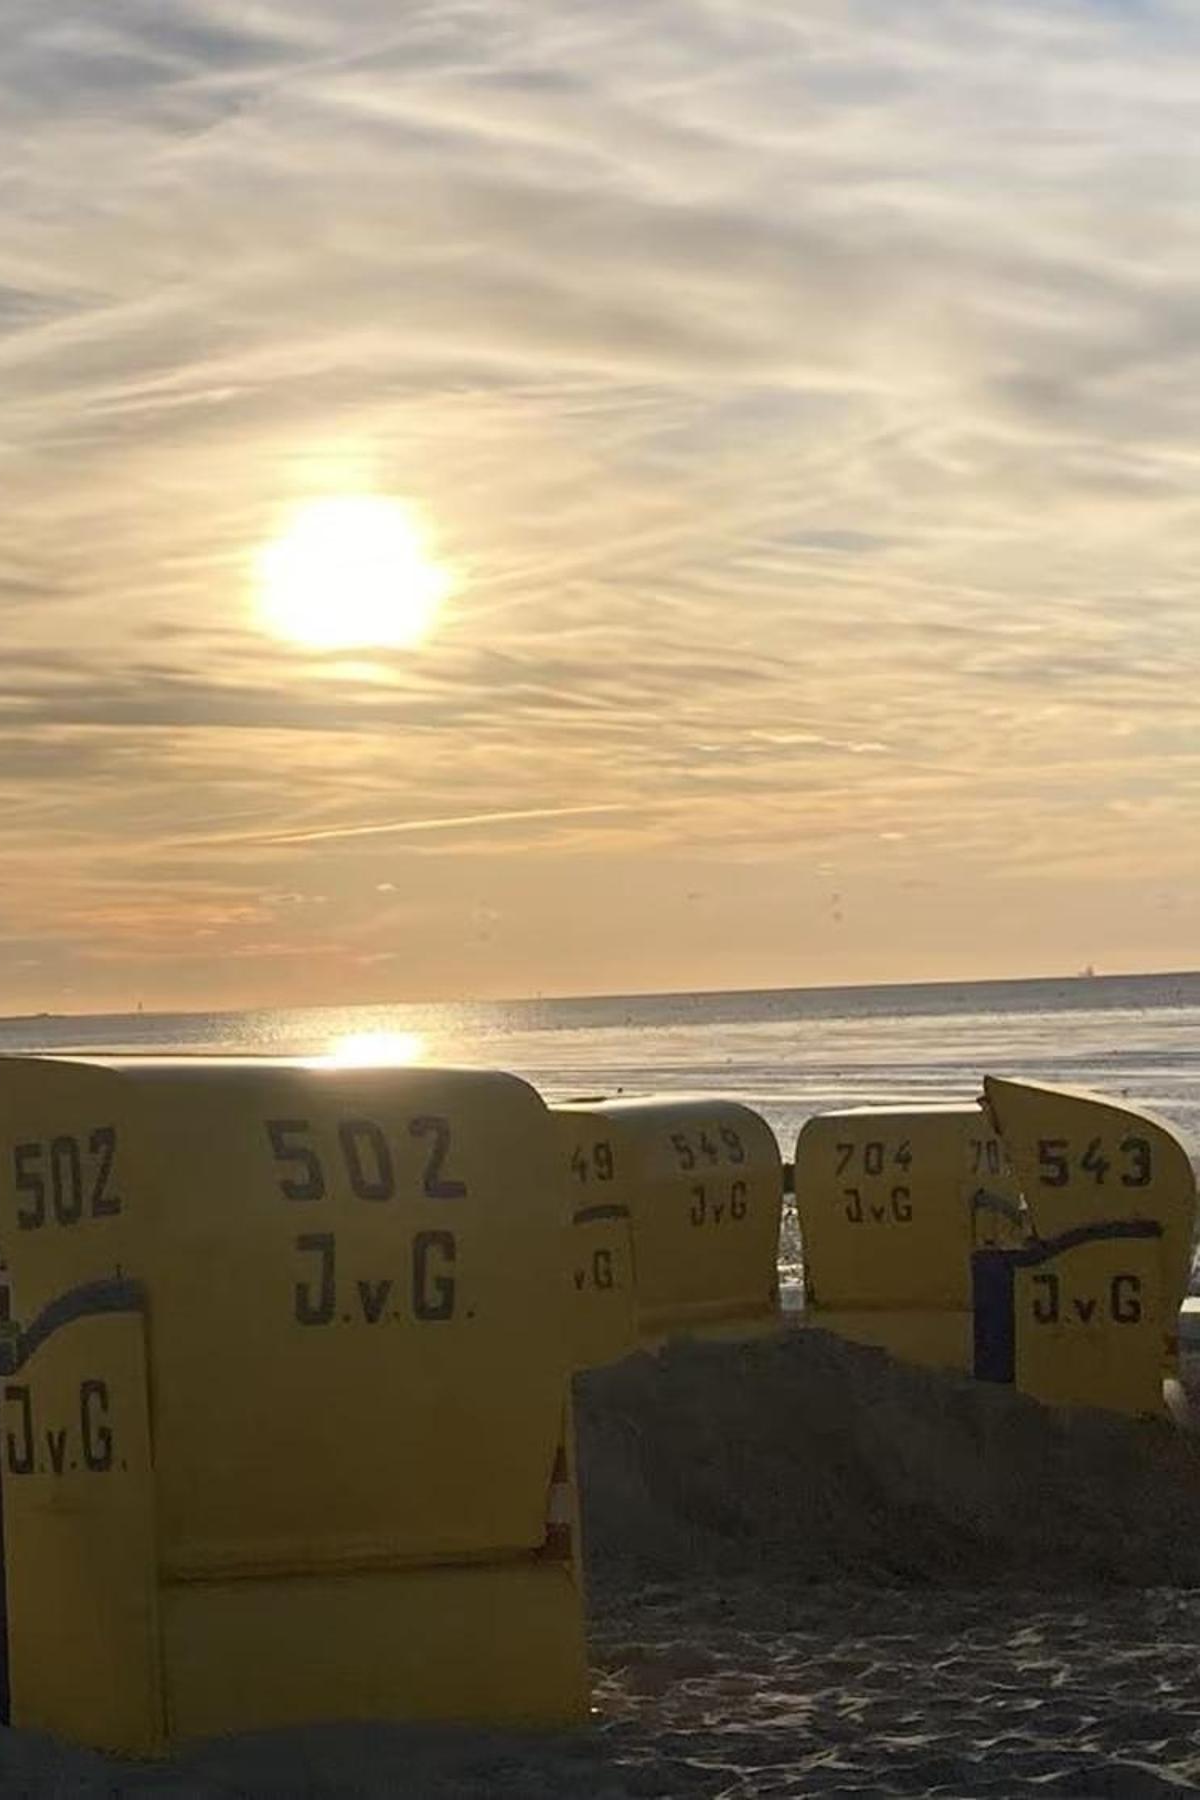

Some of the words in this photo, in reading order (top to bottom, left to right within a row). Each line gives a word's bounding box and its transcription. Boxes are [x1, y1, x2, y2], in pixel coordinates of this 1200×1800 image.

[14, 1127, 121, 1230] 502
[264, 1116, 468, 1201] 502
[669, 1125, 745, 1171] 549
[836, 1140, 913, 1177] 704
[1038, 1138, 1152, 1188] 543
[295, 1229, 476, 1326] J.v.G.
